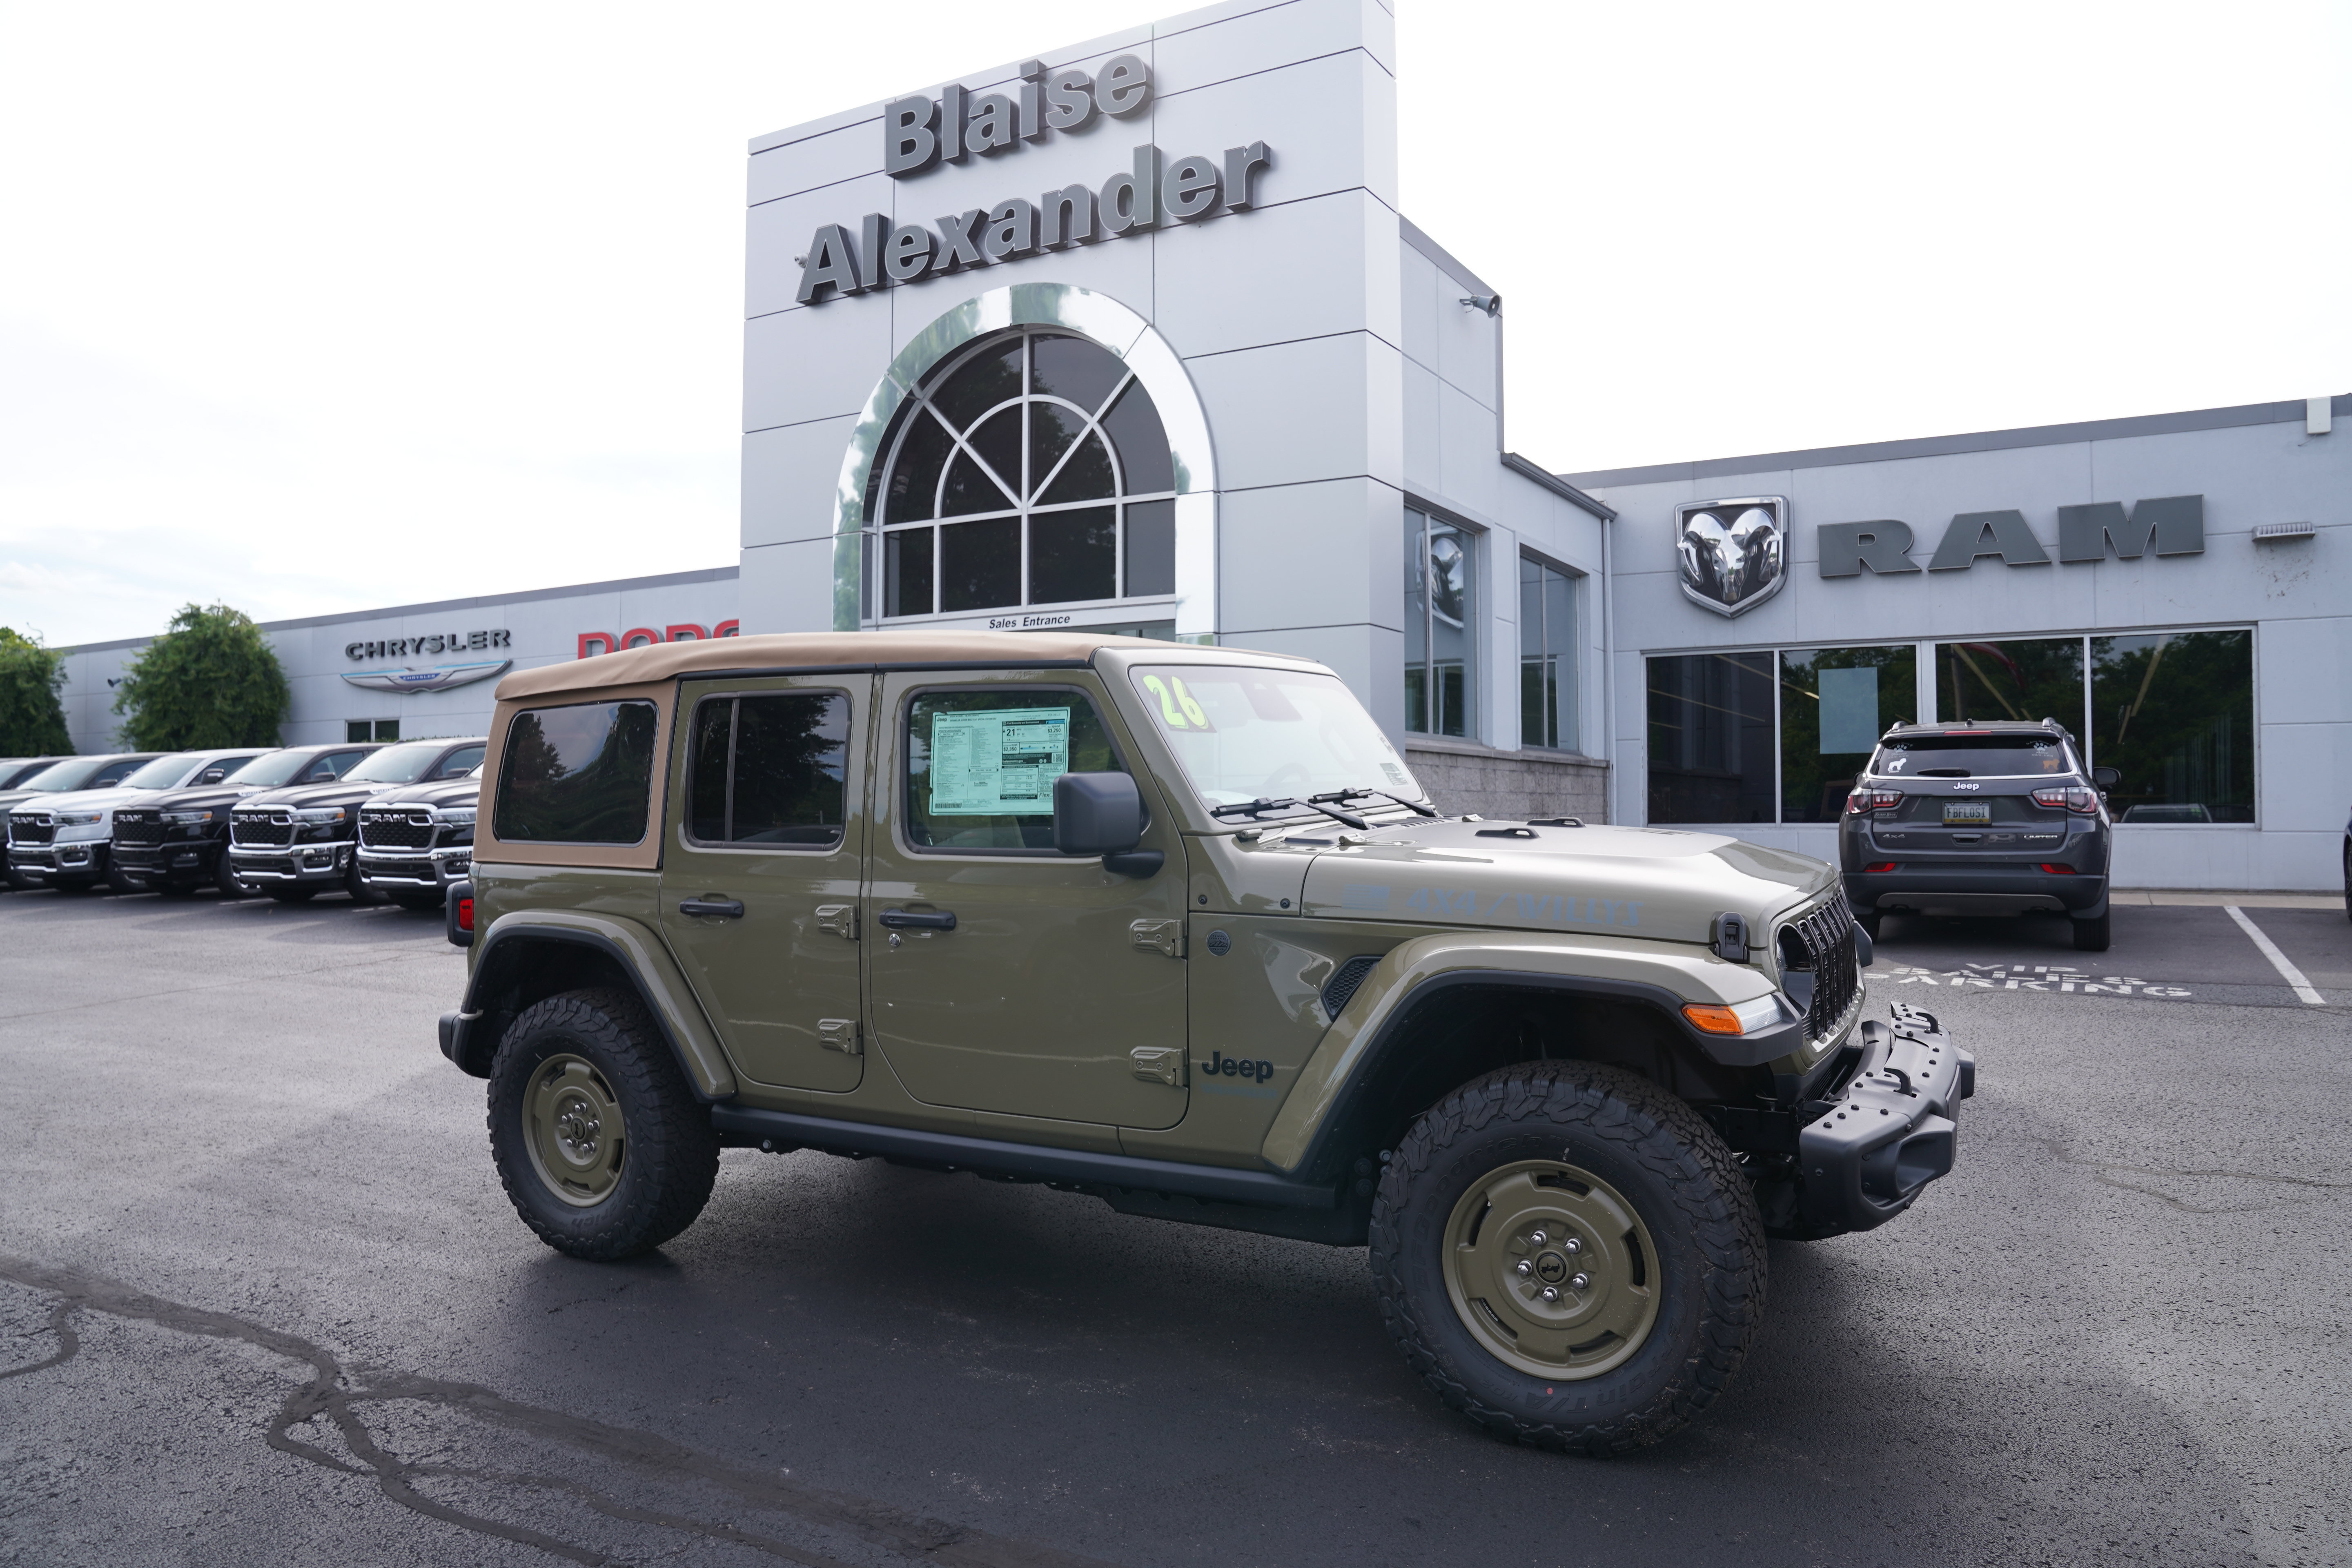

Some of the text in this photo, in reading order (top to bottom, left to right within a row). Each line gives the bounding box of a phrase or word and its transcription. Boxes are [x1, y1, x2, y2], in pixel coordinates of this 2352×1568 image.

[884, 53, 1155, 178] Blaise
[796, 140, 1271, 305] Alexander
[1817, 493, 2205, 578] RAM
[989, 615, 1071, 629] Sales Entrance
[345, 629, 511, 660] CHRYSLER
[1142, 675, 1209, 730] 26
[1953, 782, 1980, 791] Jeep
[239, 814, 269, 823] RAM
[370, 814, 406, 823] RAM
[1405, 887, 1478, 915] 4X4
[1515, 893, 1645, 927] WILLYS
[1890, 968, 2147, 984] SALES
[1966, 963, 2077, 973] VIP
[1202, 1050, 1274, 1083] Jeep
[1411, 1133, 1542, 1291] BFGoodrich
[1479, 1378, 1518, 1401] KO2
[1524, 1392, 1589, 1413] T/A
